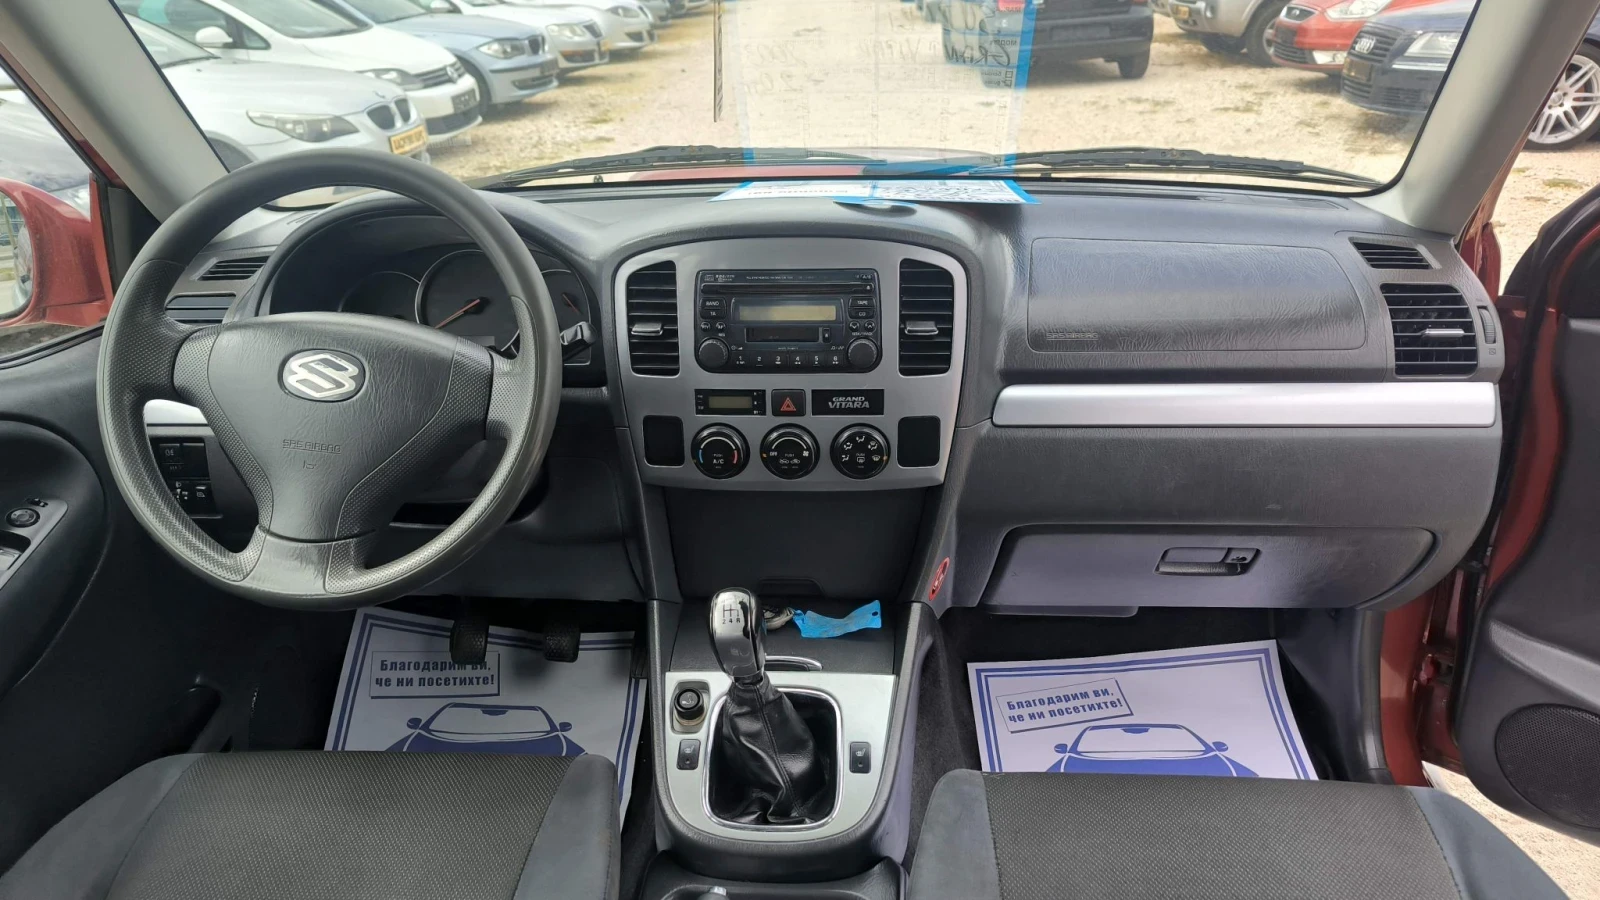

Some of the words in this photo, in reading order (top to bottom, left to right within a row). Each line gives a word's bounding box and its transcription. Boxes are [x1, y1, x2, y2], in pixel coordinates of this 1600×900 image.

[828, 401, 870, 409] VITARA
[380, 659, 467, 672] Благодарим
[375, 677, 392, 687] че
[396, 677, 414, 687] ни
[418, 674, 494, 687] посетихте!
[1007, 691, 1090, 710] Благодарим
[1008, 713, 1025, 723] че
[1028, 710, 1046, 721] ни
[1048, 697, 1124, 718] посетихте!
